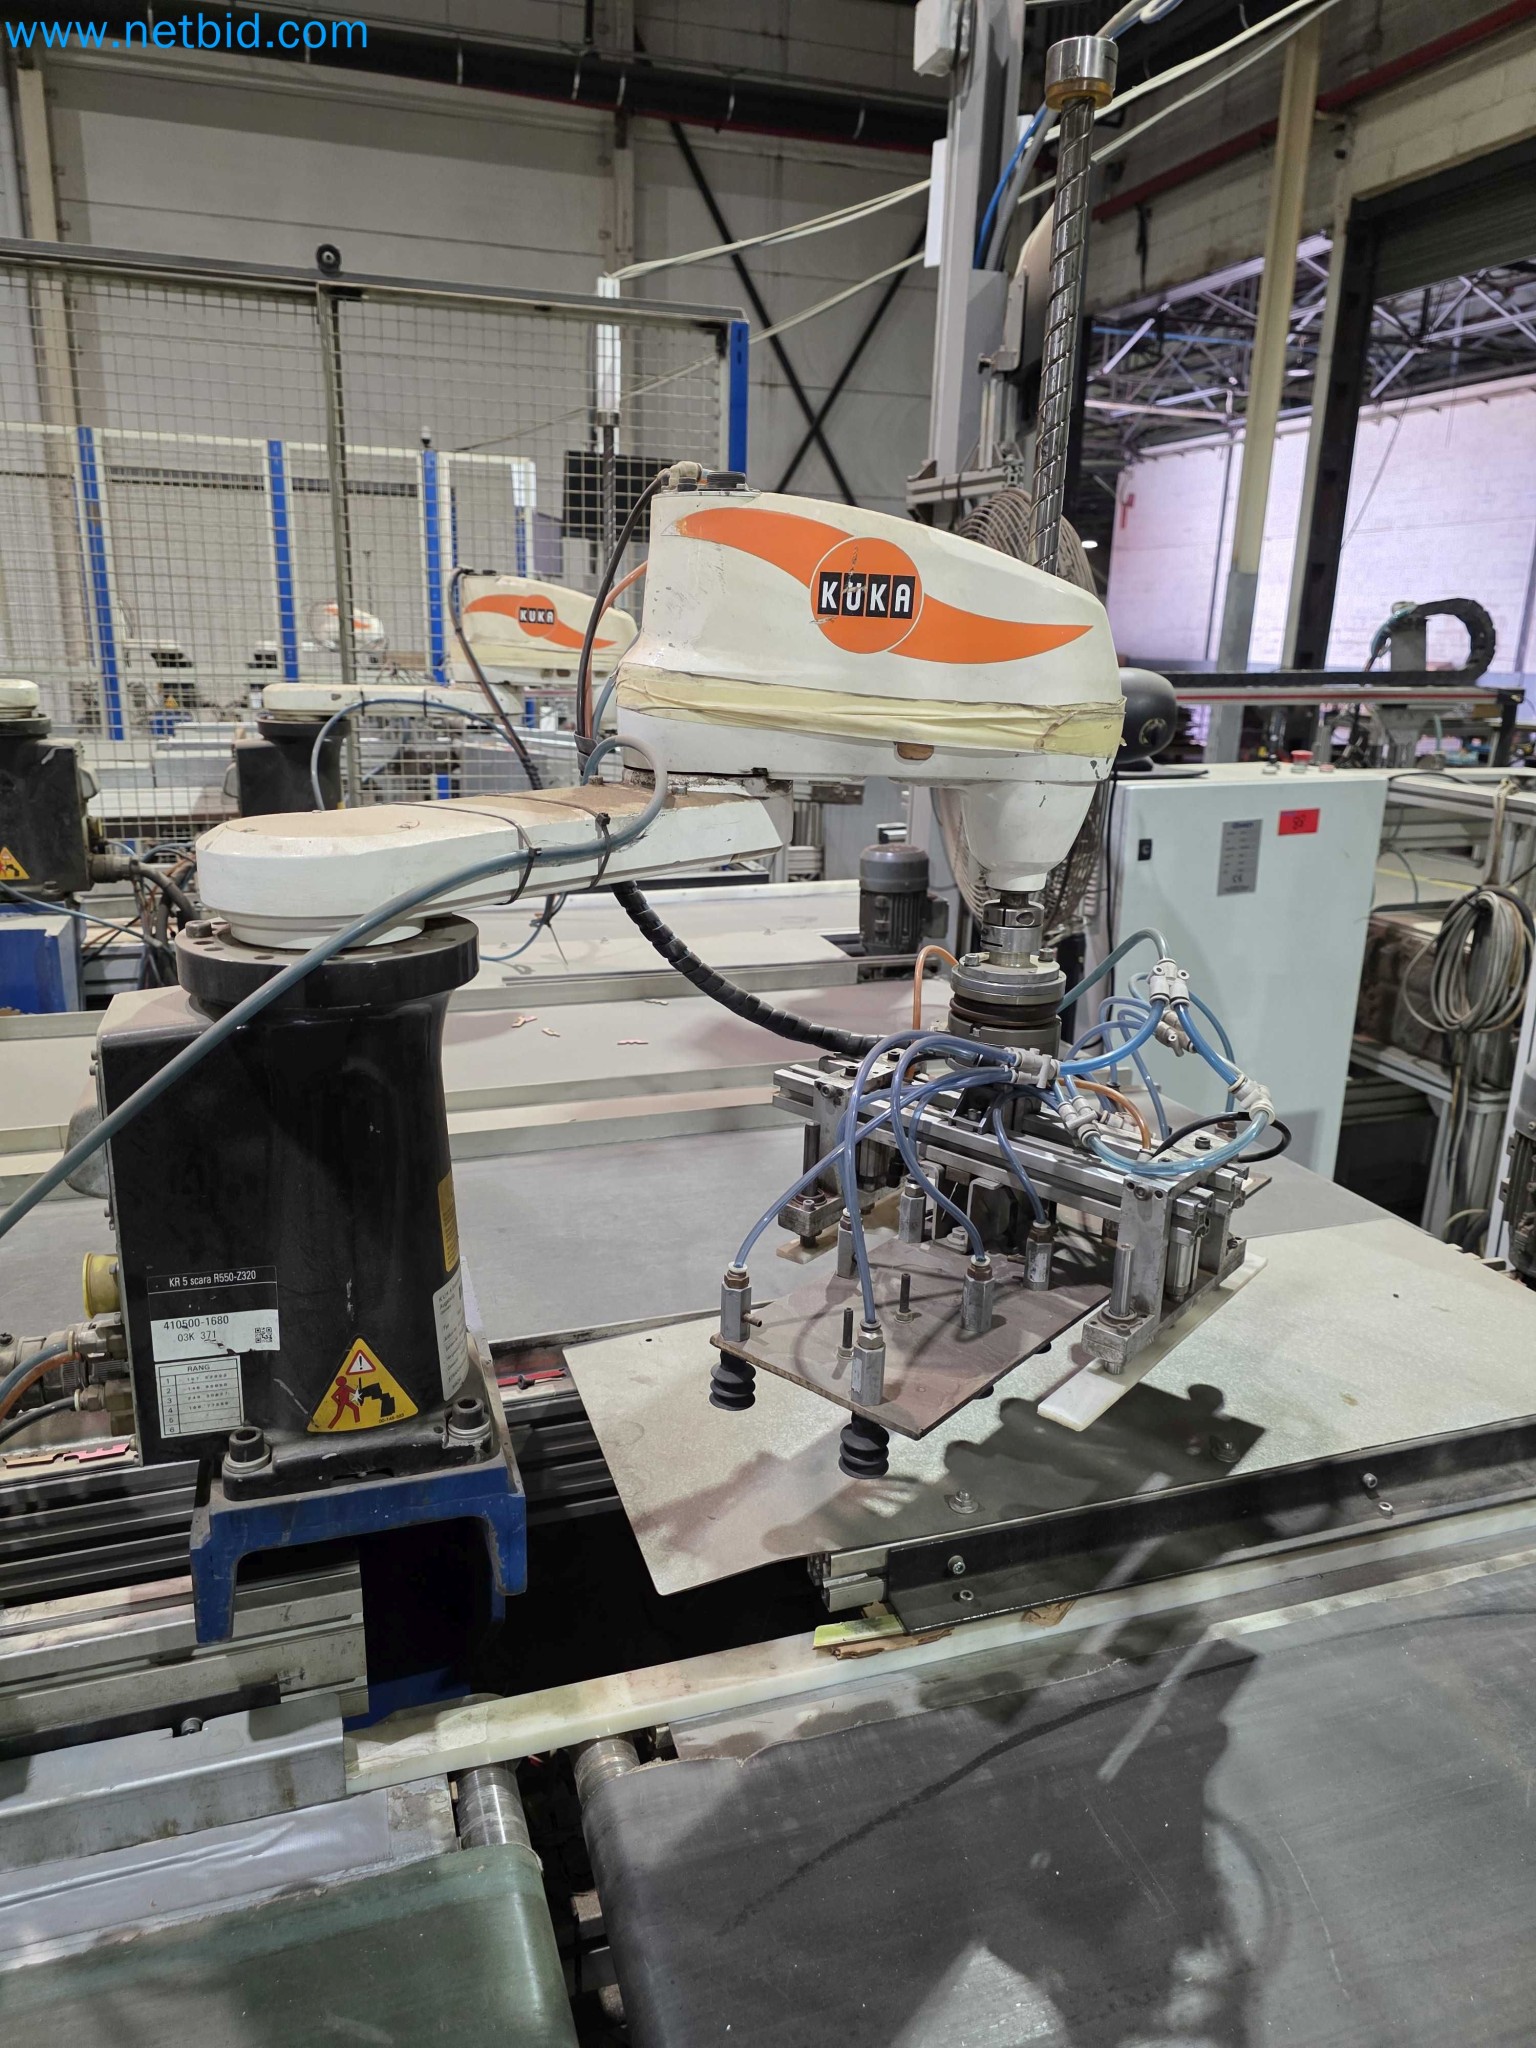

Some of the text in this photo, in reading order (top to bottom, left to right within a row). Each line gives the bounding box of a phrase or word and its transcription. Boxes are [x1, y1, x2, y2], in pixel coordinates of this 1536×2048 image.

[820, 579, 912, 613] KUKA
[520, 608, 554, 624] KUKA
[169, 1269, 257, 1288] KR 5 scara R550-Z320
[163, 1314, 230, 1330] 410500-1680
[200, 1330, 217, 1340] 371
[187, 1364, 211, 1372] RANG
